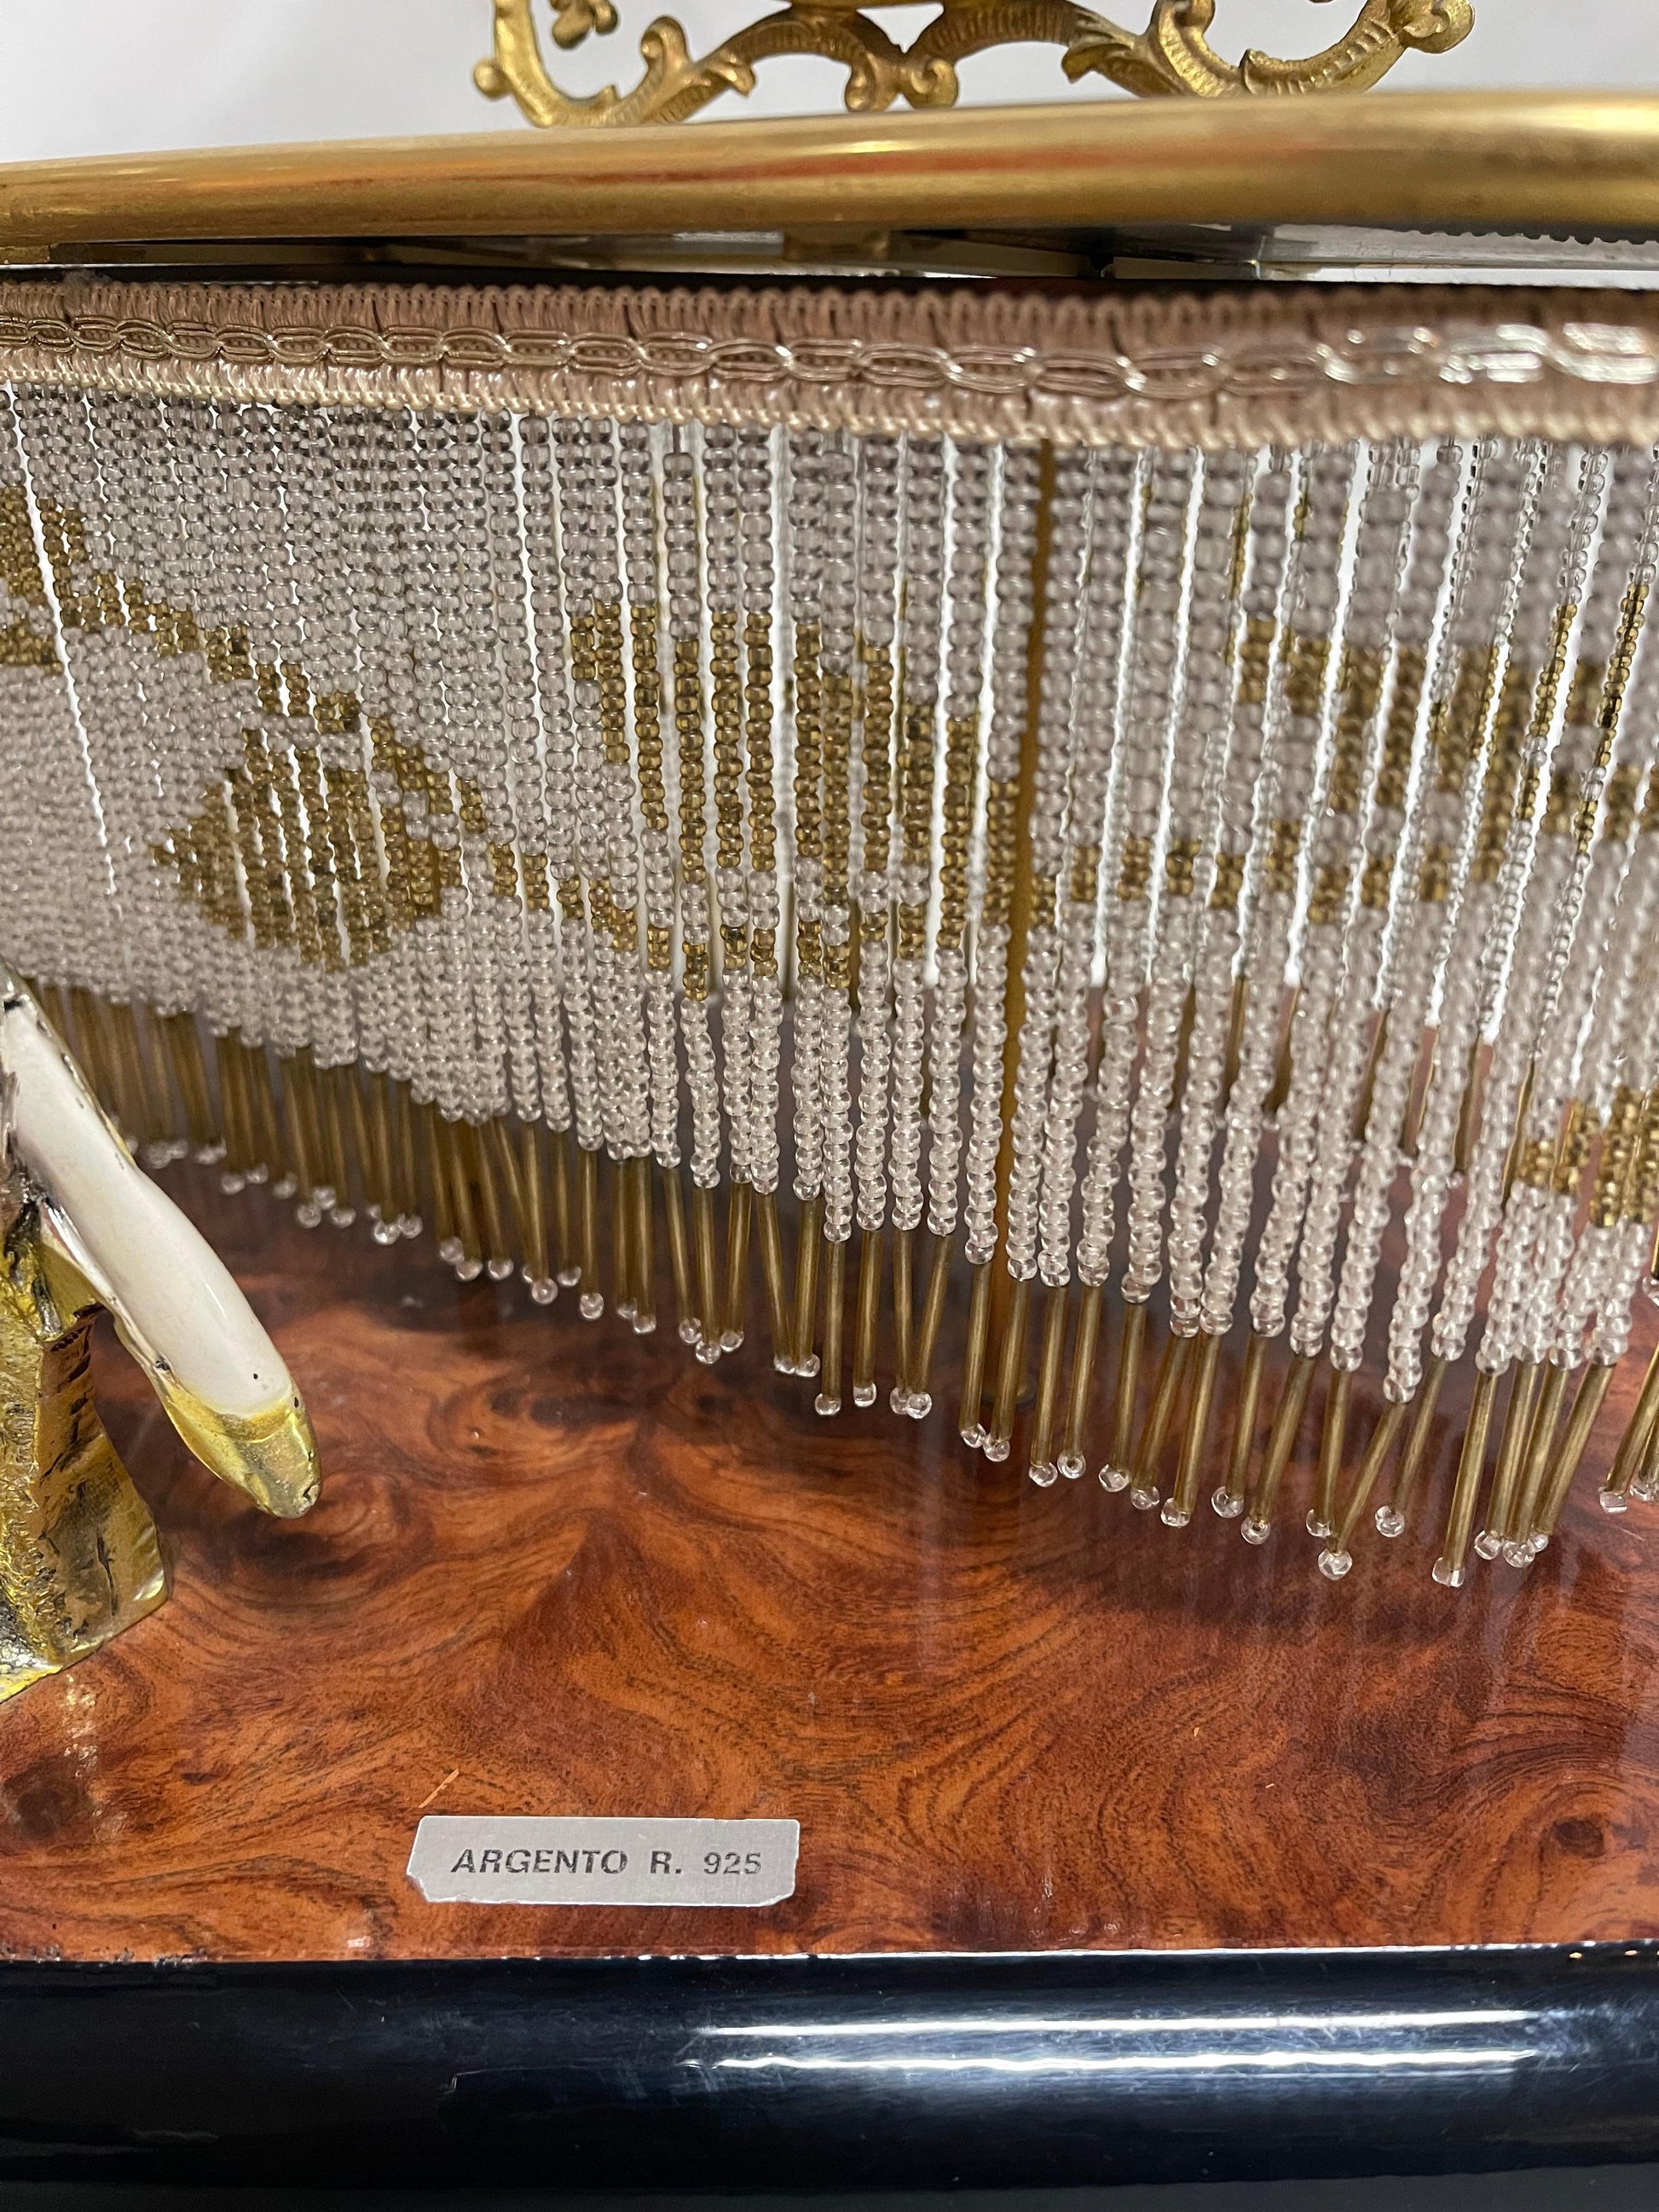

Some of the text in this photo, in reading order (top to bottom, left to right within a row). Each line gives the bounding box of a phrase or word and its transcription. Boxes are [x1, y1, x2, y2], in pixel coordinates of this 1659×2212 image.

[450, 1848, 762, 1875] ARGENTO R. 925
